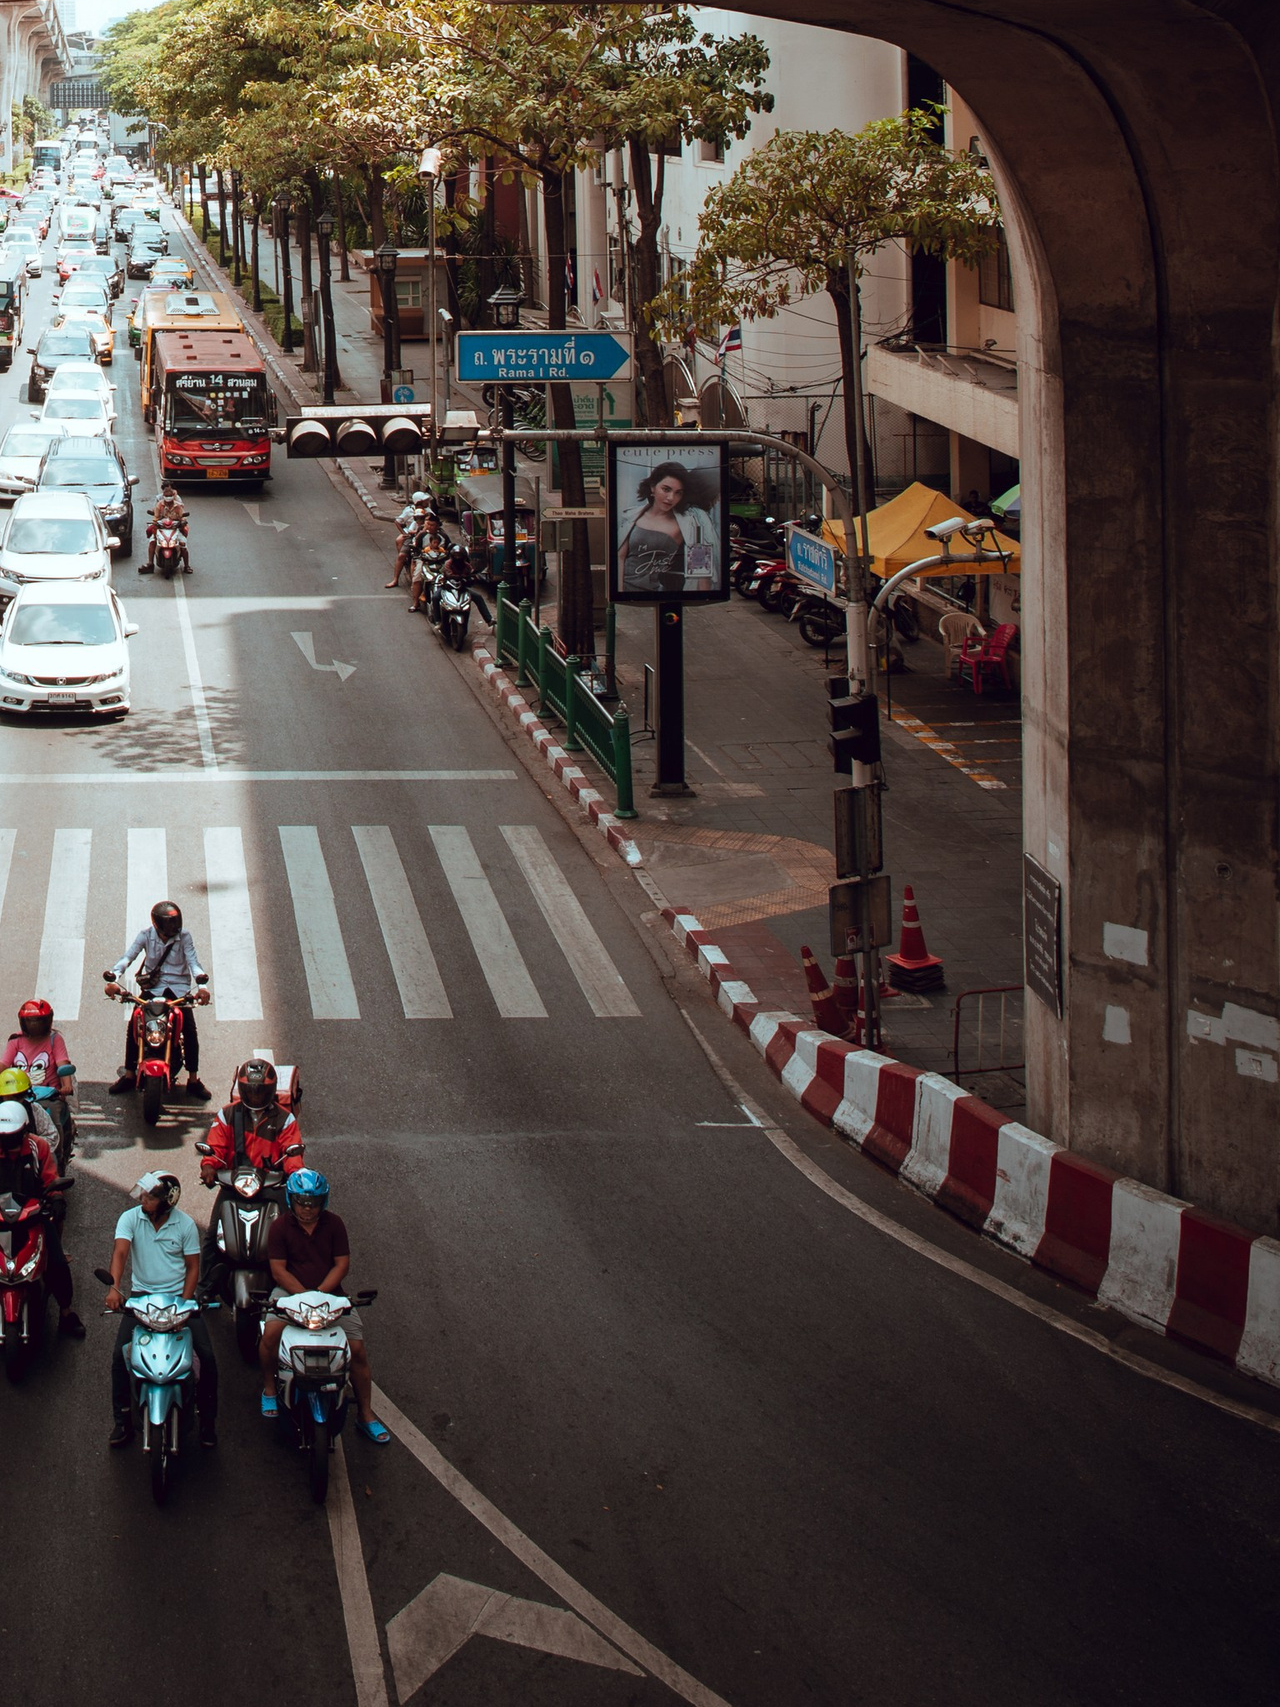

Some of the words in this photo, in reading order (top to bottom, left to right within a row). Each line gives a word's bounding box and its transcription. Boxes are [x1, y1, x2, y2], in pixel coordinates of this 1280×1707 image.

[474, 351, 488, 366] ถ.
[499, 368, 535, 377] Rama
[549, 368, 569, 377] Rd.
[176, 375, 206, 388] ศรีย่าน
[210, 375, 223, 386] 14
[227, 378, 257, 392] สวนลุม
[623, 447, 661, 457] cute
[667, 447, 715, 460] press
[635, 549, 678, 574] Just
